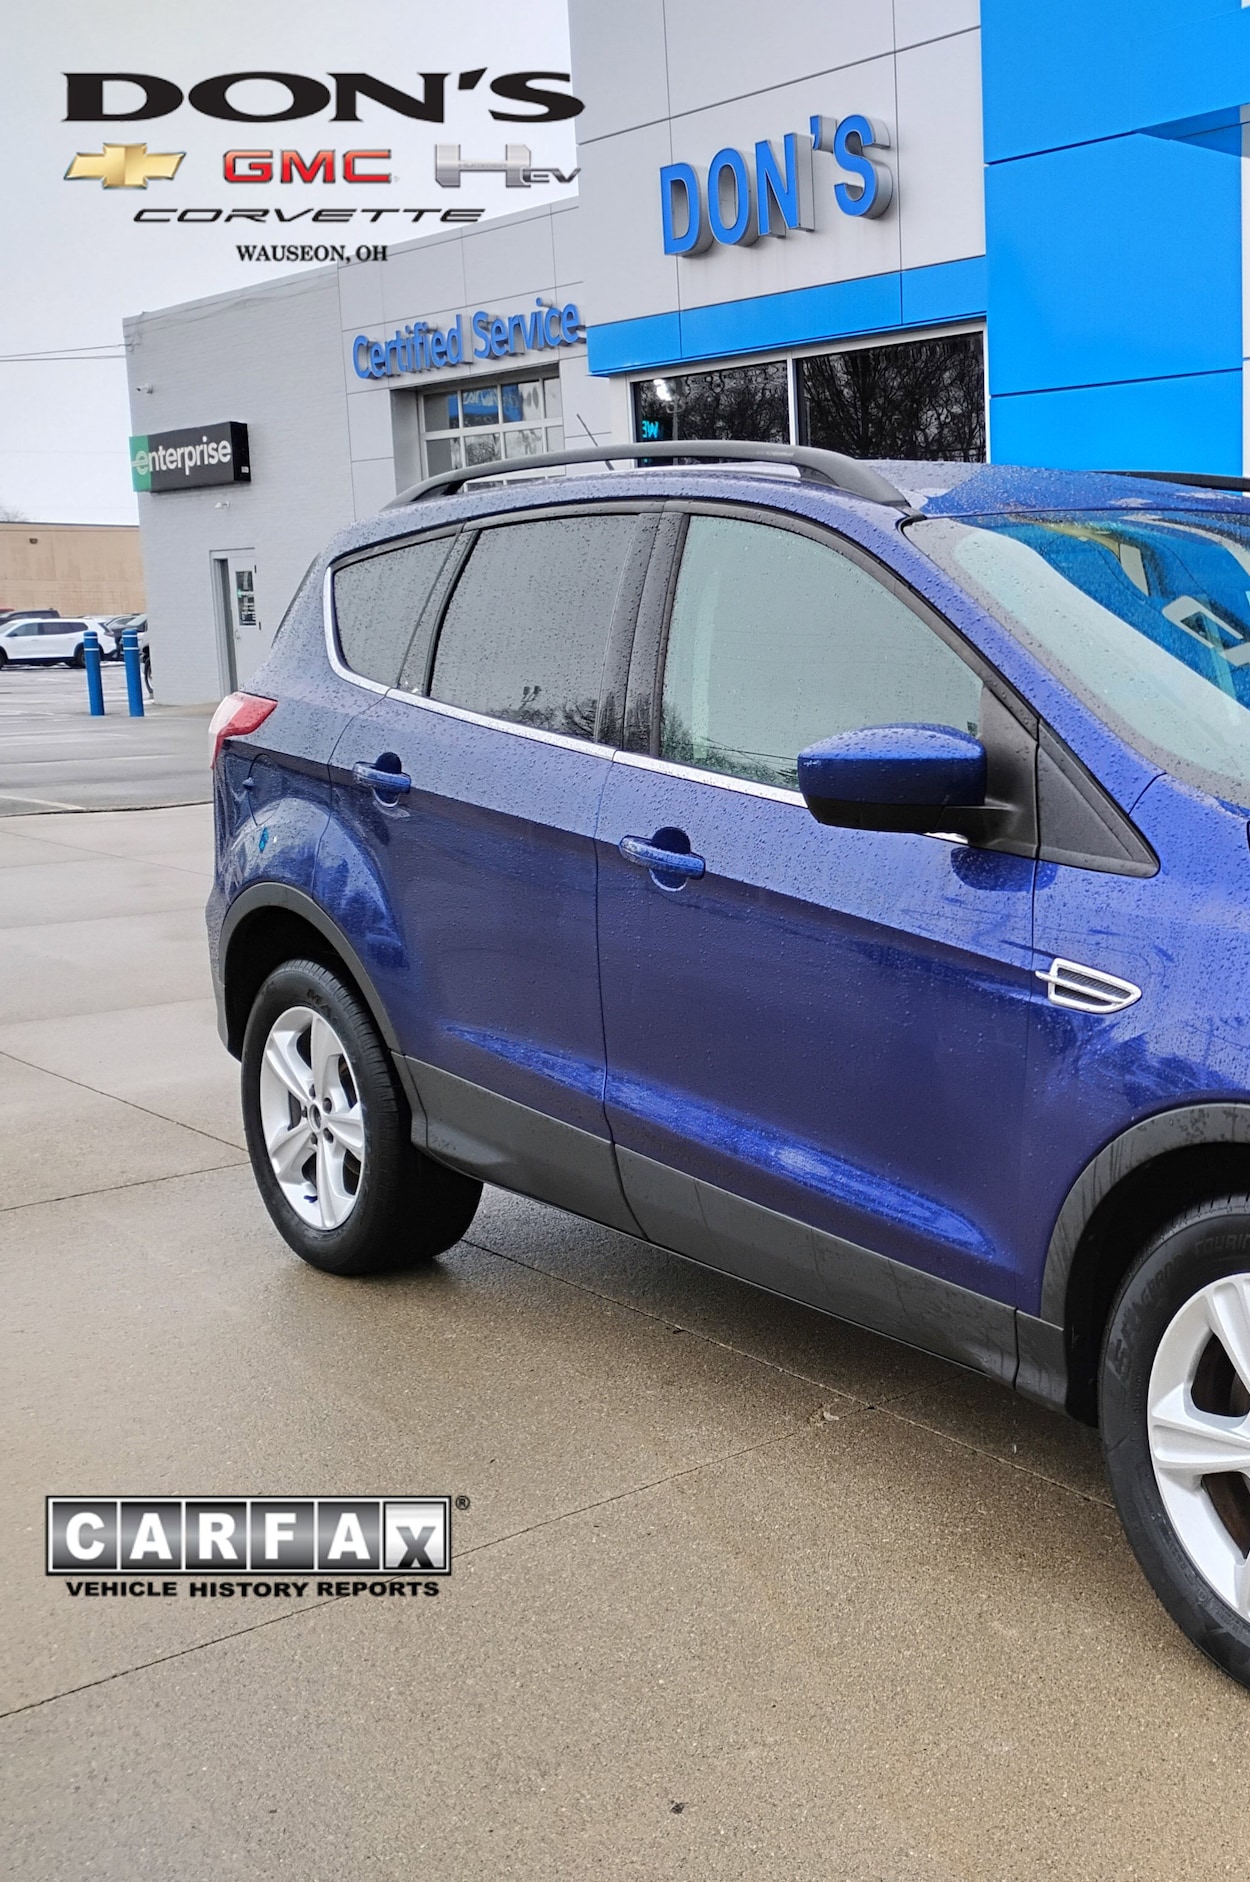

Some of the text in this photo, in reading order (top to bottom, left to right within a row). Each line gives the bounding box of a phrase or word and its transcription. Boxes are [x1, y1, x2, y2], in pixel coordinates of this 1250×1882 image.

[659, 113, 893, 257] DON'S
[353, 297, 581, 379] Certified Service
[134, 435, 231, 476] enterprise
